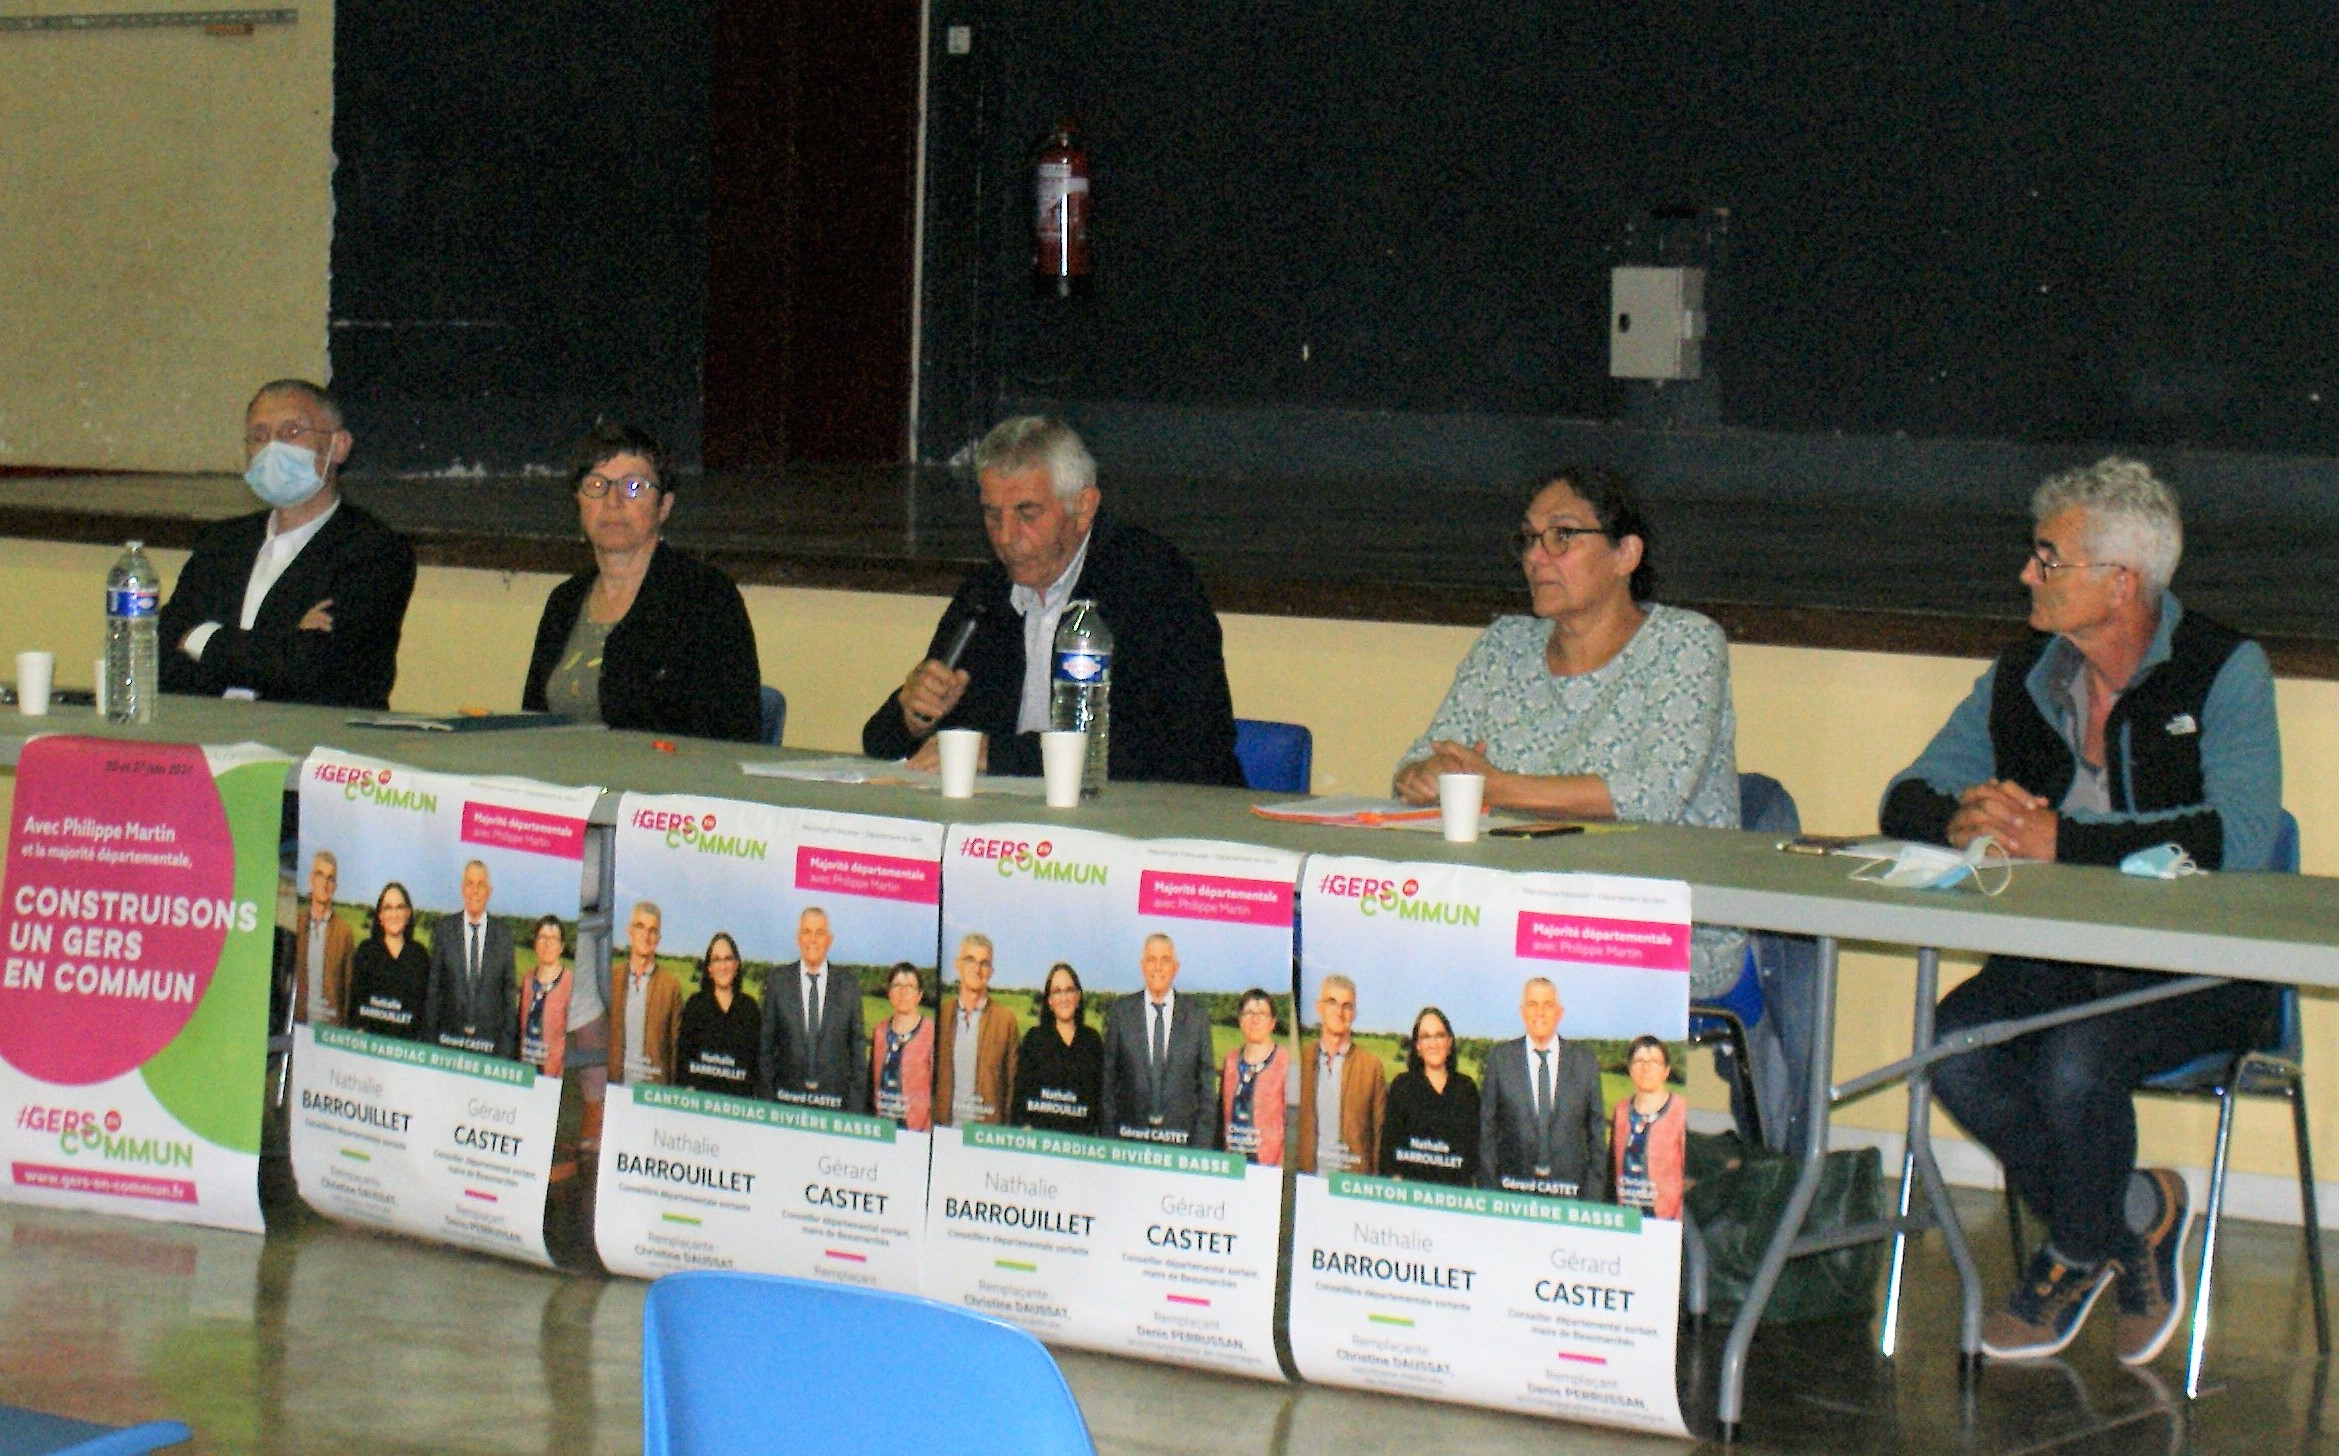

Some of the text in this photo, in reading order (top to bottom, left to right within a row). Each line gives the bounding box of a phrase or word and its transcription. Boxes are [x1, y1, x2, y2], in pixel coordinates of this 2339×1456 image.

[344, 776, 437, 814] COMMUN
[24, 816, 176, 842] Avec Philippe Martin
[666, 823, 768, 859] COMMUN
[21, 843, 193, 869] et la majorité départementale,
[810, 857, 925, 881] Majorité départementale
[998, 850, 1108, 885] COMMUN
[1154, 881, 1278, 903] Majorité départementale
[1318, 874, 1395, 901] #GERS
[14, 885, 258, 932] CONSTRUISONS
[1360, 889, 1481, 926] COMMUN
[9, 922, 143, 961] UN GERS
[1533, 923, 1673, 946] Majorité départementale
[1559, 941, 1603, 957] Philippe
[1606, 945, 1643, 959] Martin
[4, 958, 196, 1003] EN COMMUN
[302, 1089, 413, 1133] BARROUILLET
[468, 1098, 517, 1125] Gérard
[644, 1090, 699, 1109] CANTON
[704, 1100, 765, 1120] PARDIAC
[833, 1119, 881, 1137] BASSE
[61, 1123, 193, 1168] COMMUN
[454, 1125, 523, 1157] CASTET
[653, 1128, 720, 1157] Nathalie
[1151, 1130, 1189, 1144] CASTET
[975, 1131, 1230, 1174] CANTON PARDIAC RIVIÈRE BASSE
[1396, 1149, 1464, 1169] BARROUILLET
[616, 1152, 756, 1194] BARROUILLET
[818, 1156, 877, 1181] Gérard
[805, 1184, 888, 1214] CASTET
[986, 1171, 1057, 1199] Nathalie
[1501, 1176, 1579, 1197] Gérard CASTET
[945, 1198, 1096, 1237] BARROUILLET
[1161, 1194, 1225, 1221] Gérard
[1341, 1181, 1625, 1228] CANTON PARDIAC RIVIÈRE BASSE
[1147, 1225, 1238, 1255] CASTET
[1354, 1222, 1433, 1252] Nathalie
[1312, 1249, 1477, 1291] BARROUILLET
[1551, 1249, 1621, 1276] Gérard
[1535, 1279, 1634, 1312] CASTET
